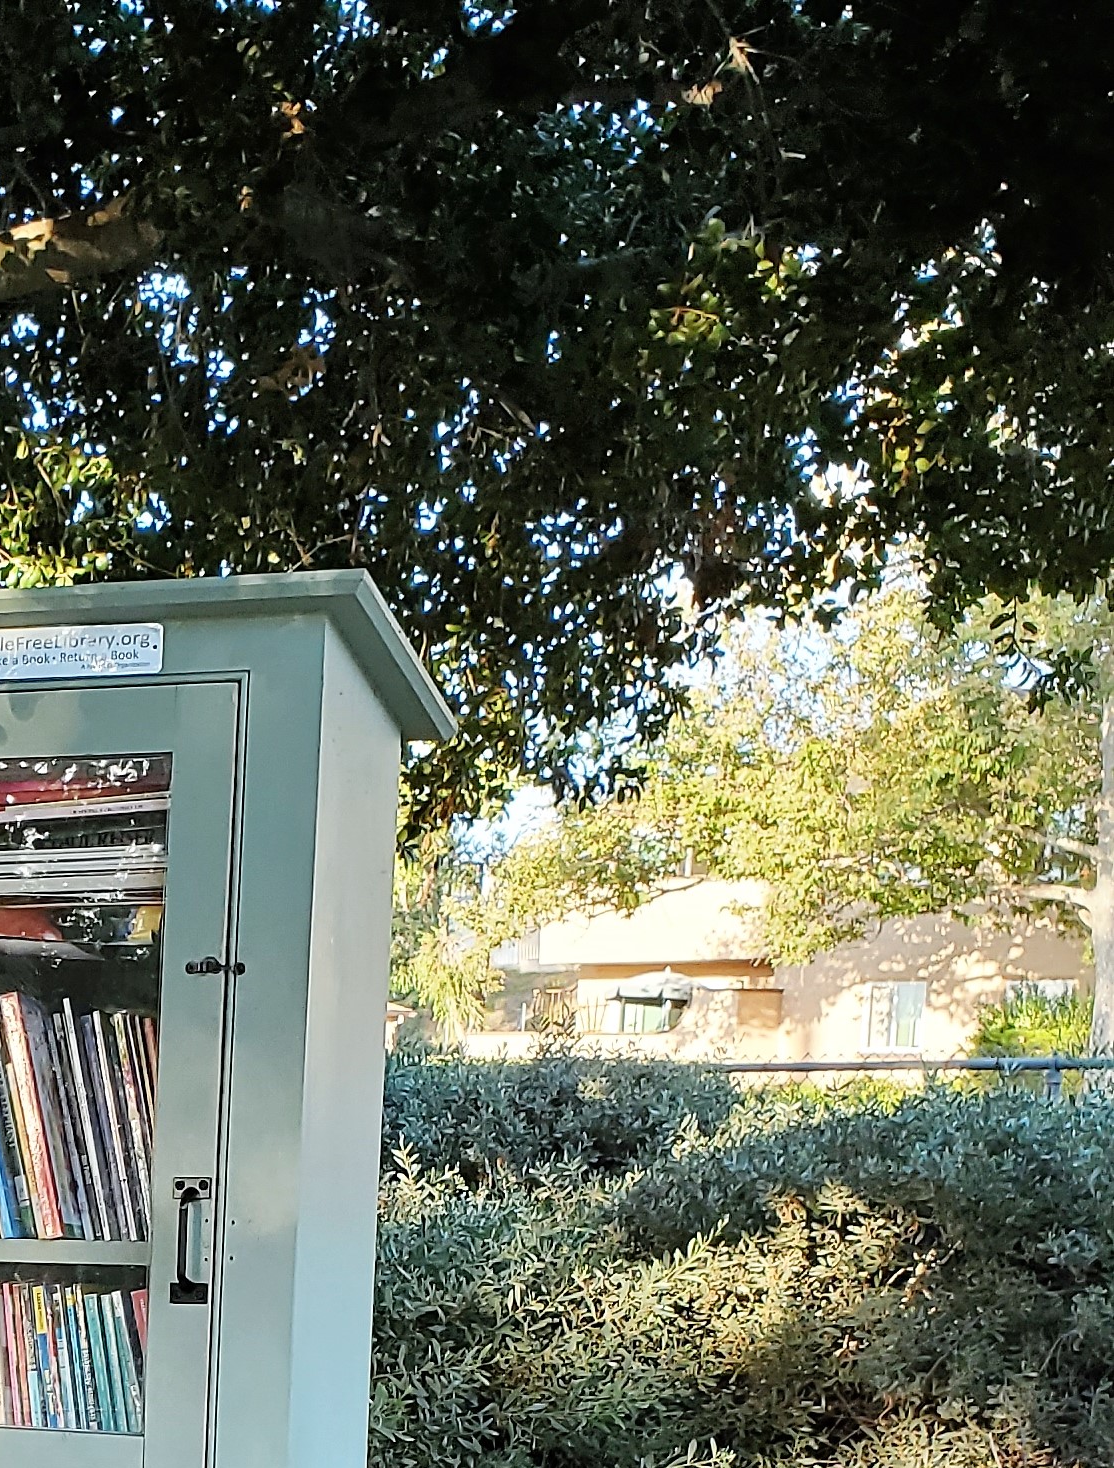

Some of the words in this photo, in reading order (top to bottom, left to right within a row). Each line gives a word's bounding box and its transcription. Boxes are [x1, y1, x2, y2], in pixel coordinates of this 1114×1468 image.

[12, 658, 18, 666] a
[22, 653, 50, 665] Book
[111, 649, 139, 661] Book
